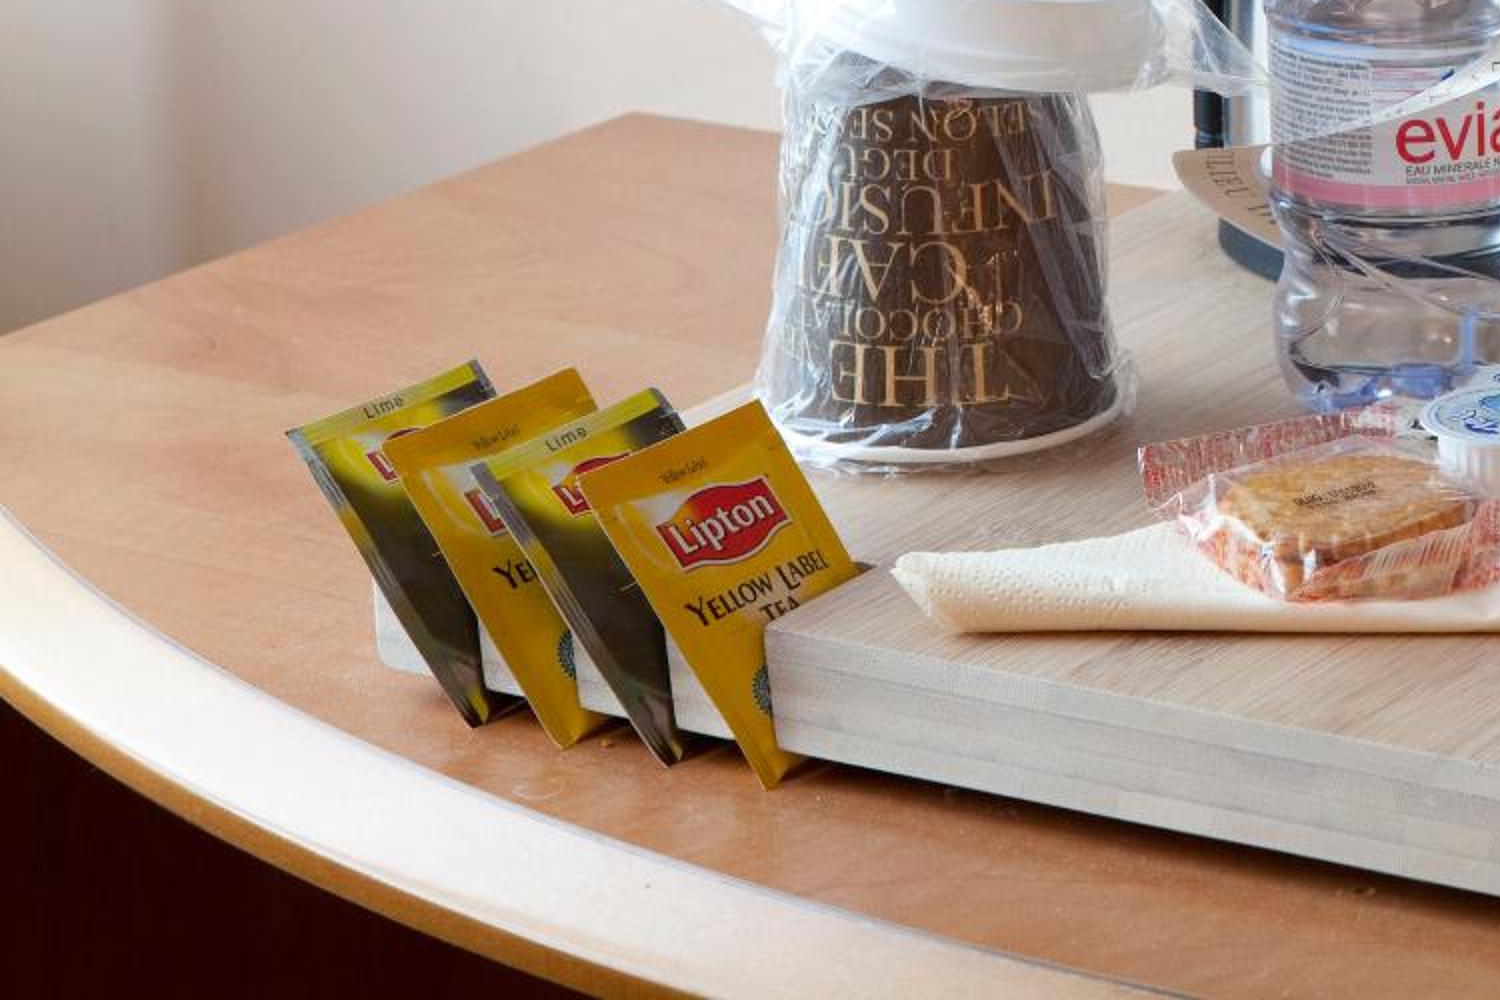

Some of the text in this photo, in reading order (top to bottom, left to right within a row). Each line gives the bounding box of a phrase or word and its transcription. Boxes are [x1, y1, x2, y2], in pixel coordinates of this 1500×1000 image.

[1405, 164, 1431, 177] EAU
[362, 395, 405, 419] Lime
[544, 427, 588, 452] Lime
[669, 495, 775, 555] Lipton
[684, 548, 830, 627] YELLOW LABEL
